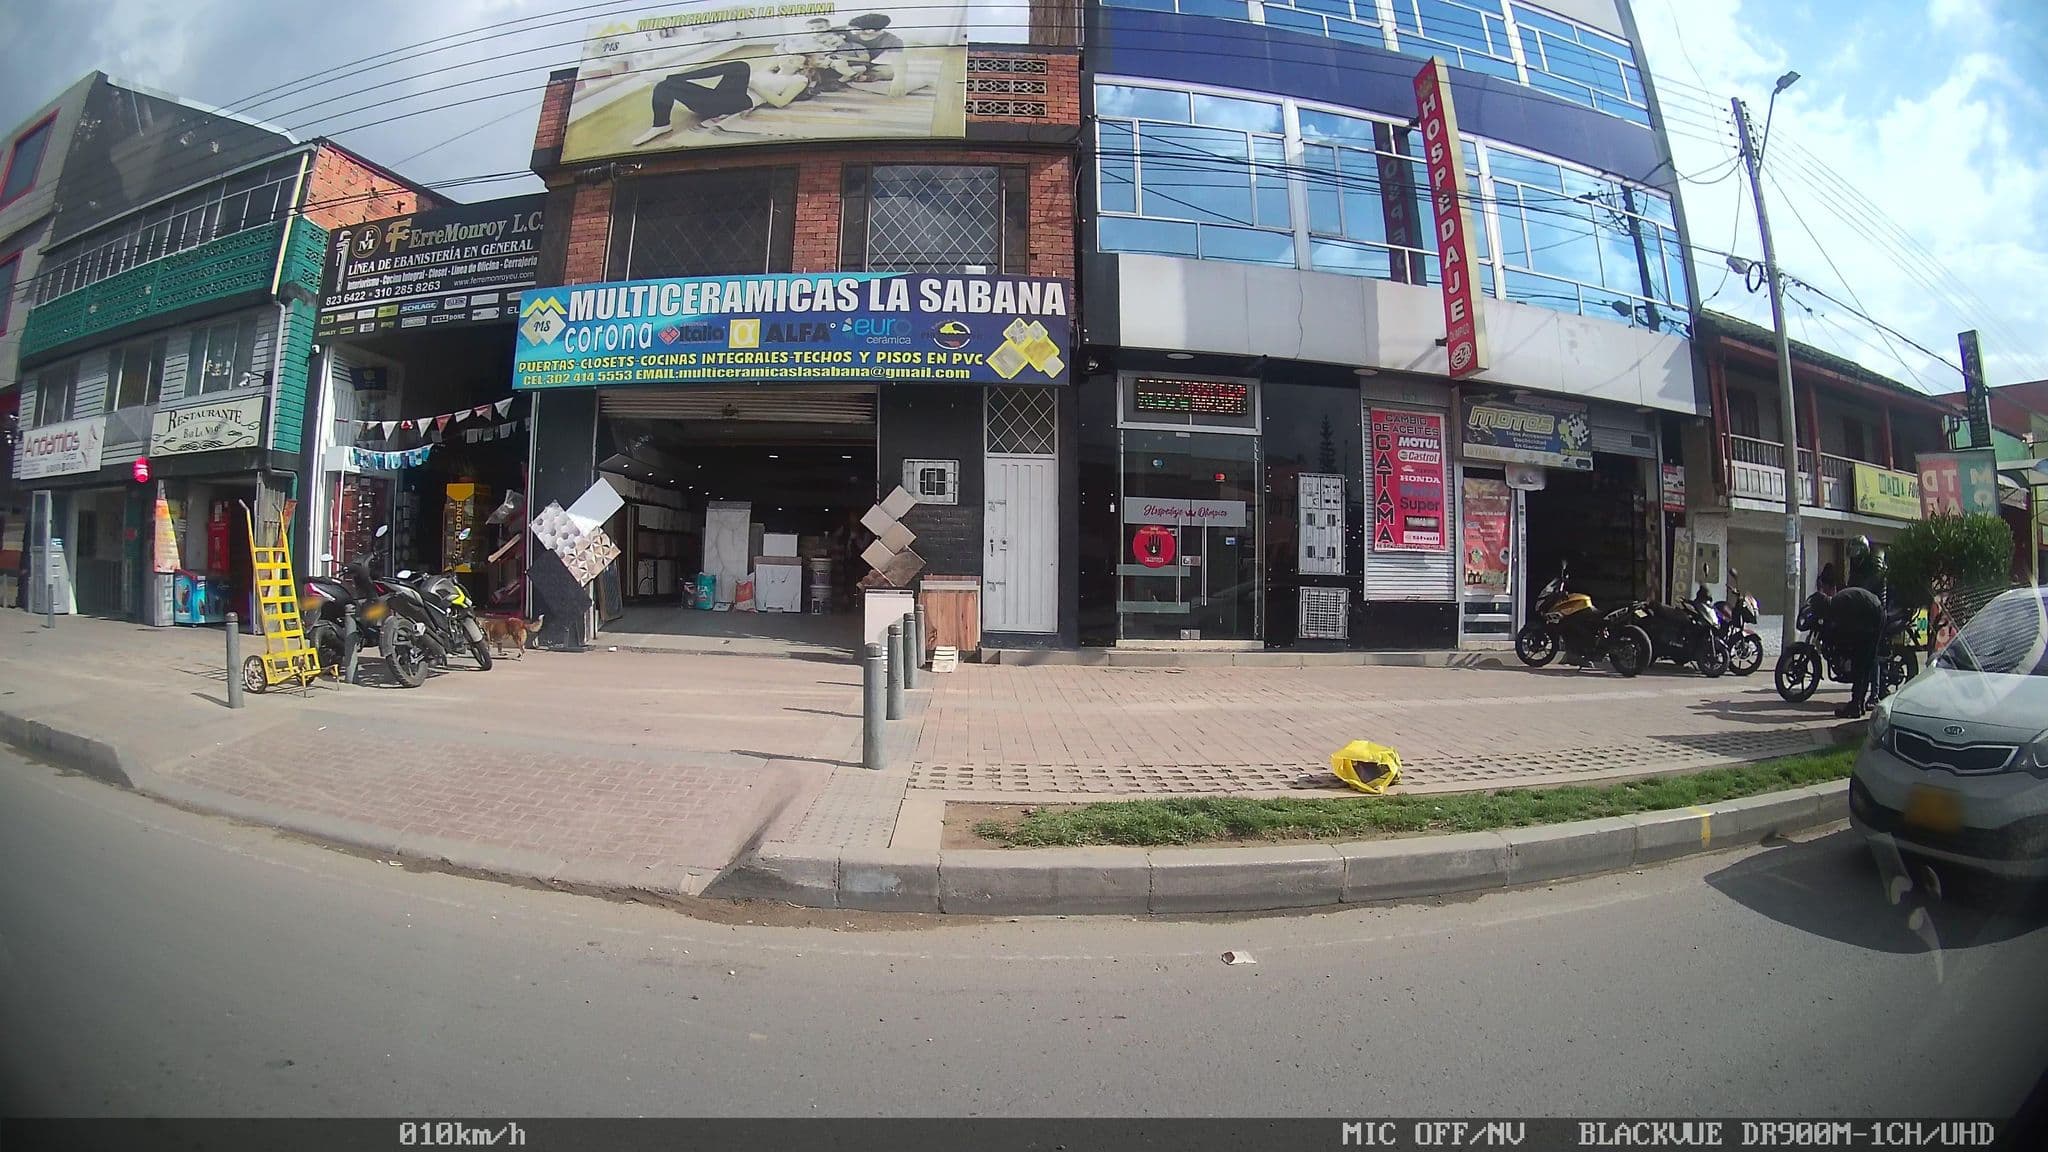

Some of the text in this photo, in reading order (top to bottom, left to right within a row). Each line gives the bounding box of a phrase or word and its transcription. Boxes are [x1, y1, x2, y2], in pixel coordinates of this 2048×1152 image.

[1421, 93, 1466, 324] HOSPEDAJE
[347, 239, 534, 276] LÍNEA DE EBANISTERÍA EN GENERAL
[326, 280, 441, 306] 823 6422 310 285 8263
[568, 278, 1067, 322] MULTICERAMICAS LA SABANA
[764, 322, 831, 344] ALFA
[854, 317, 912, 337] euro
[564, 321, 653, 353] corona
[858, 351, 871, 363] Y
[876, 352, 922, 365] PISOS
[927, 352, 947, 364] EN
[952, 353, 984, 365] PVC
[573, 371, 595, 384] 414
[597, 370, 633, 382] 5553
[1385, 415, 1427, 425] CAMBIO
[1373, 422, 1439, 437] DE ACEITES
[1398, 436, 1440, 449] MOTUL
[1408, 451, 1438, 463] Castrol
[1400, 474, 1441, 484] HONDA
[1400, 497, 1440, 512] Super
